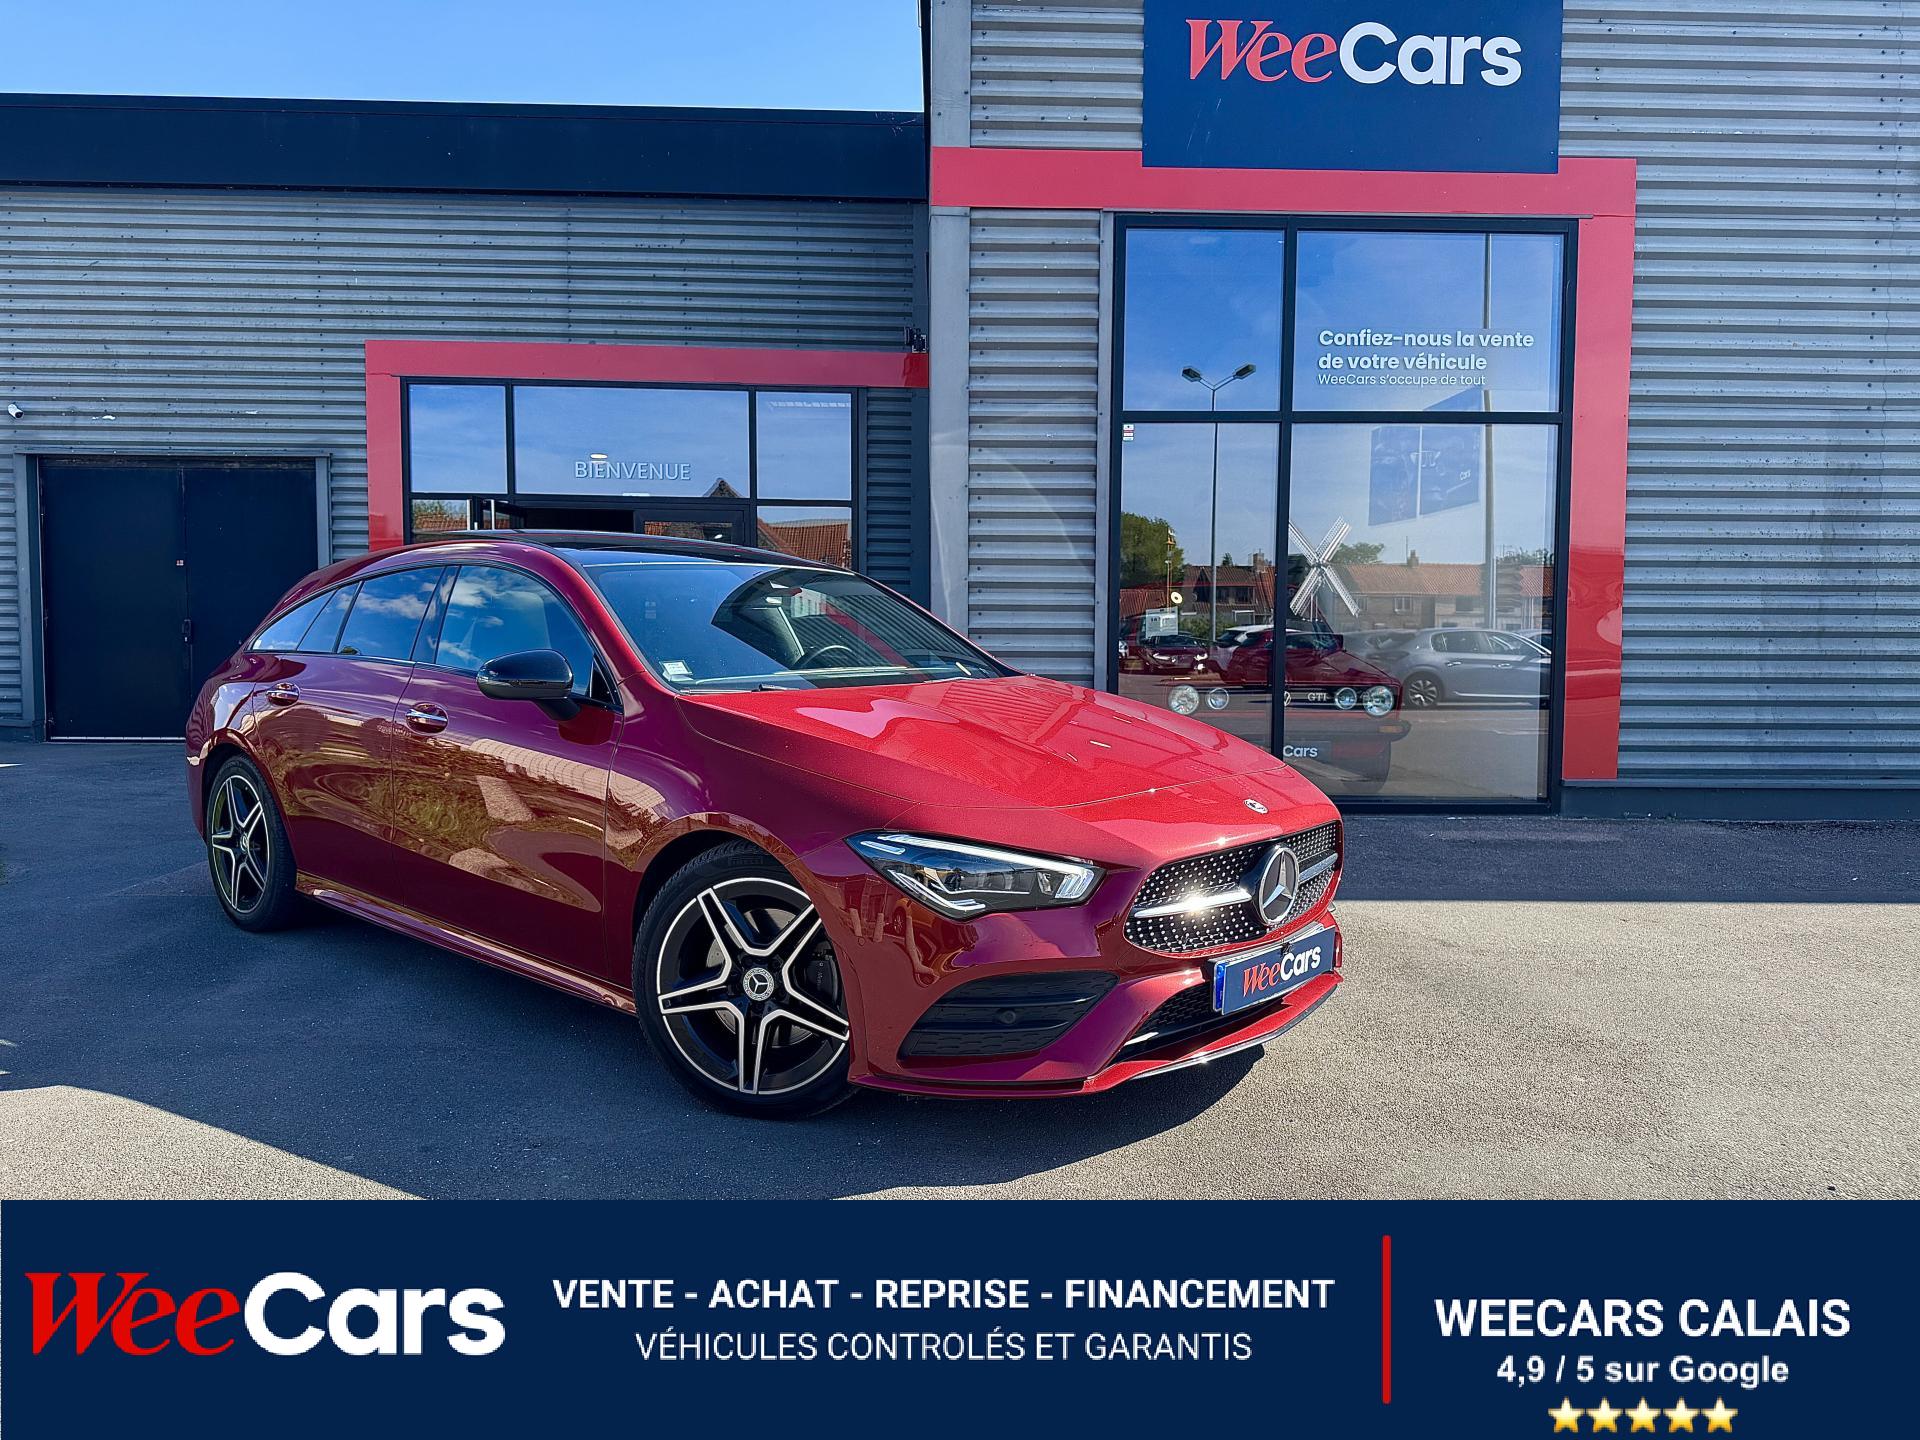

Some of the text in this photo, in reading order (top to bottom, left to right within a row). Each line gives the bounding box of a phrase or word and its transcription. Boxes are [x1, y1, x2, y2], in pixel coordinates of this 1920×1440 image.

[1186, 19, 1522, 87] WeeCars
[1319, 329, 1534, 347] Confiez-nous la vente
[1318, 352, 1487, 370] de votre véhicule
[1318, 374, 1376, 385] WeeCars
[1440, 374, 1457, 385] de
[1460, 376, 1486, 386] tout
[575, 461, 691, 480] BIENVENUE
[1307, 692, 1328, 702] GTI
[1282, 744, 1319, 758] Cars
[1243, 946, 1322, 997] WeeCars
